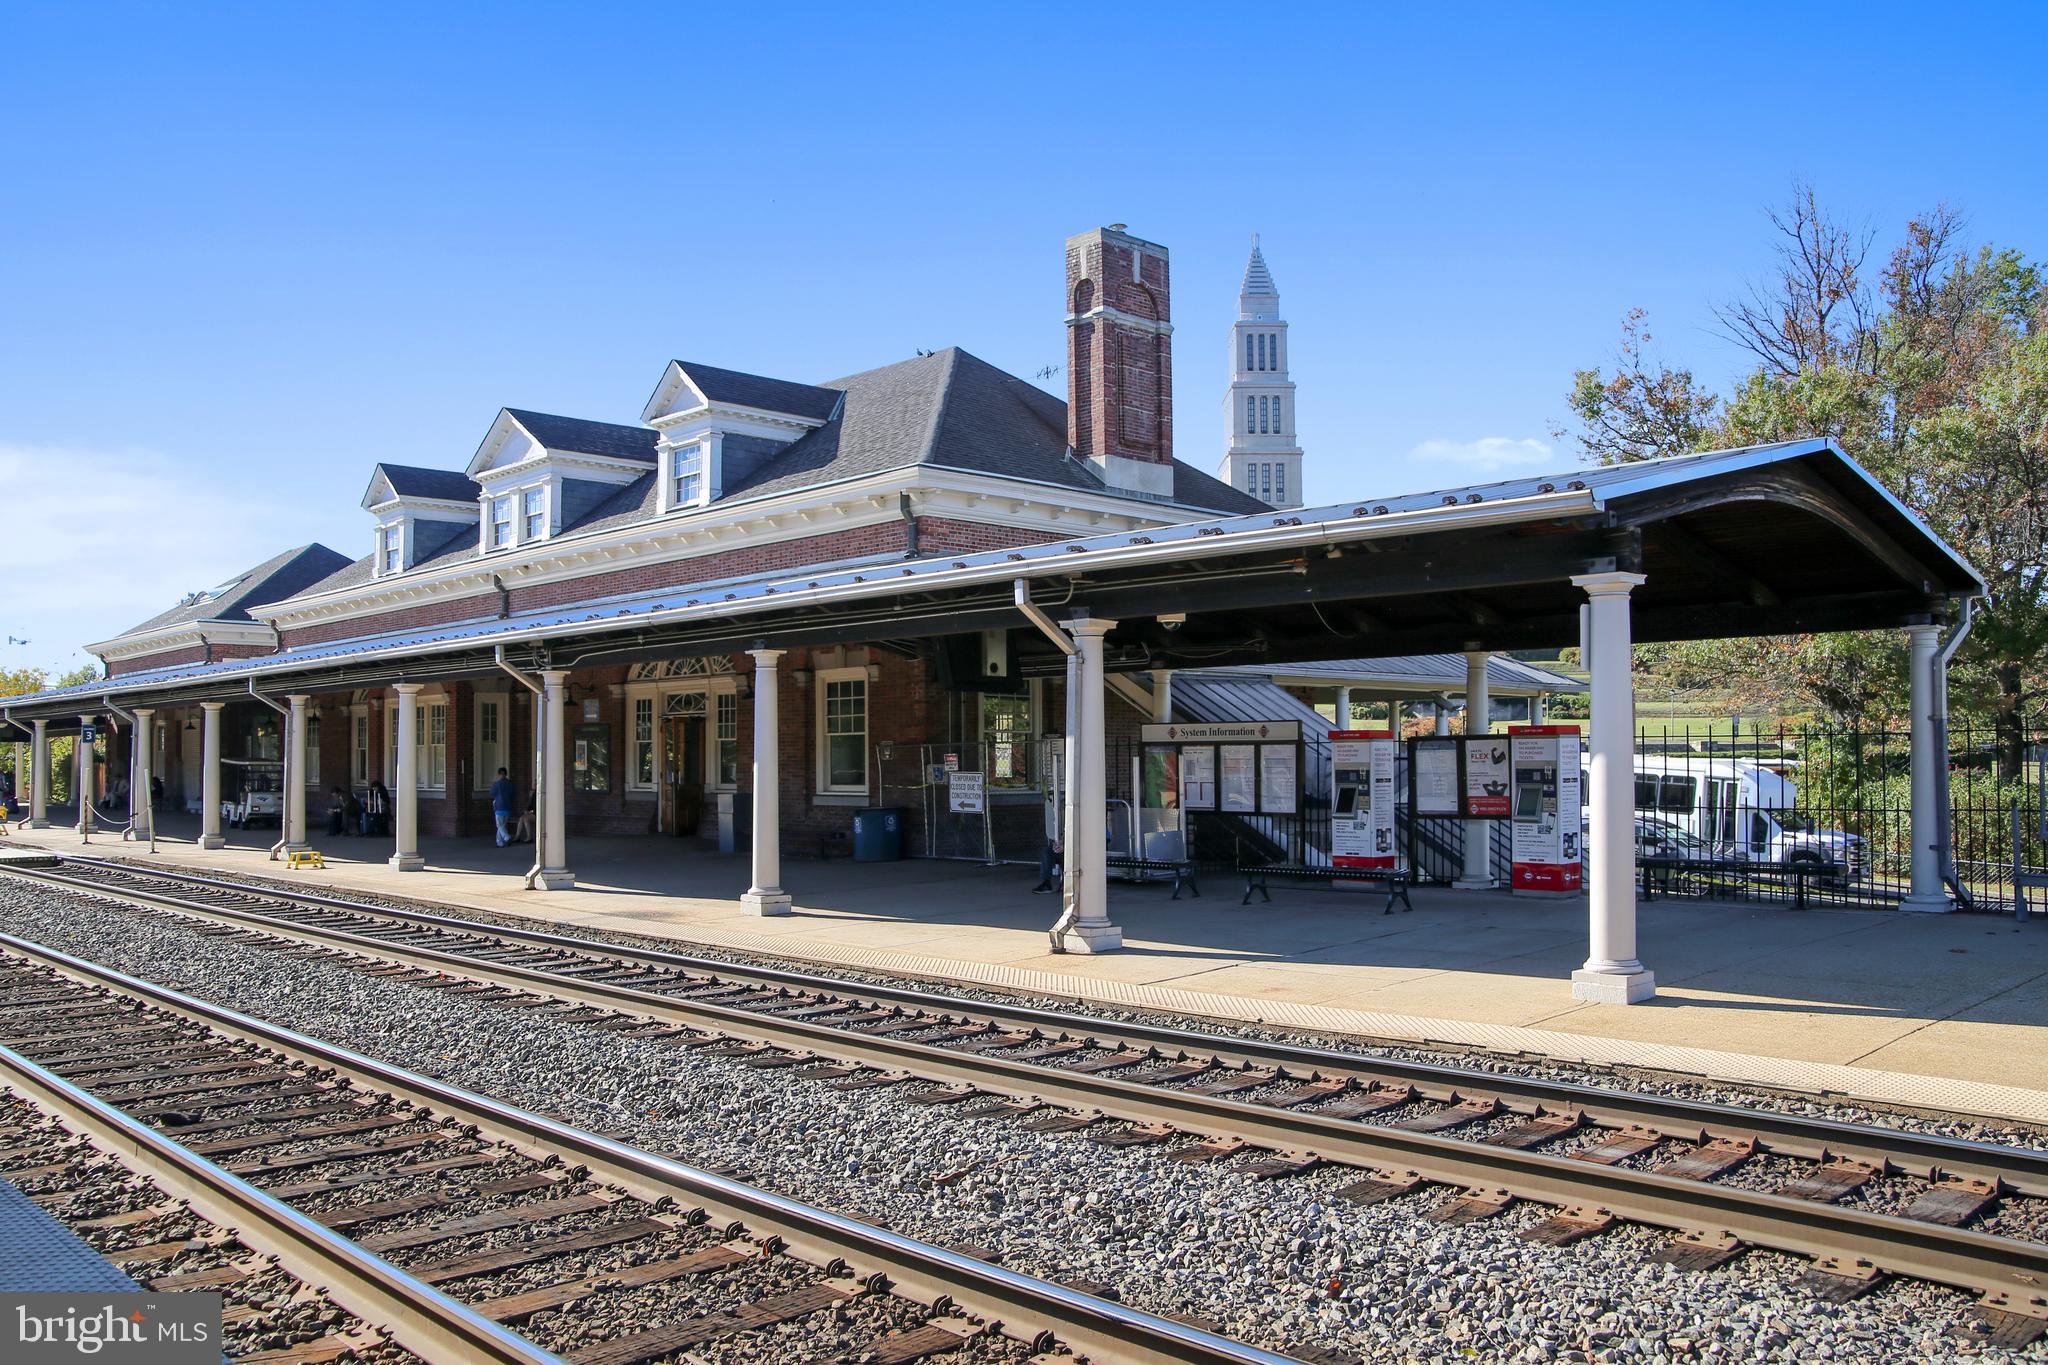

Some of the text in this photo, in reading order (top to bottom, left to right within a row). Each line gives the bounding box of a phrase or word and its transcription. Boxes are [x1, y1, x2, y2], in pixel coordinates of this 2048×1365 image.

[86, 731, 92, 740] 3
[1180, 727, 1255, 738] System Information
[951, 783, 966, 791] CLOSED
